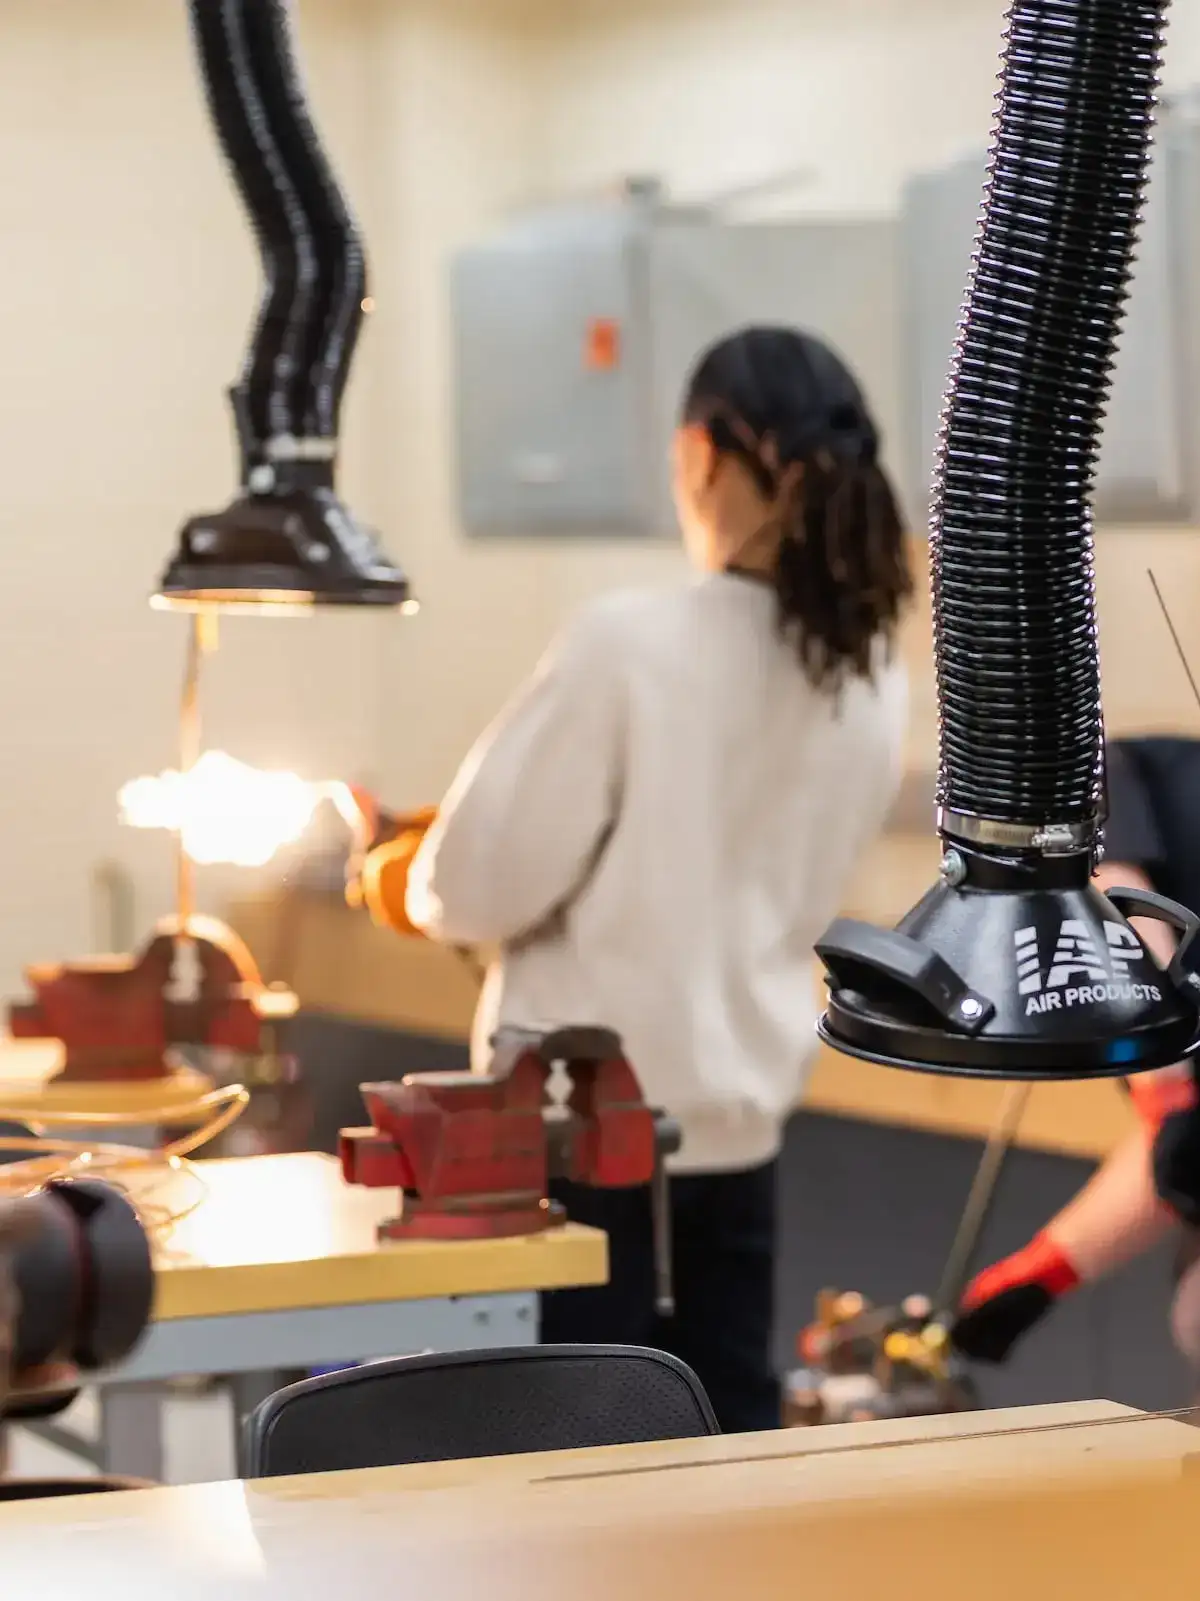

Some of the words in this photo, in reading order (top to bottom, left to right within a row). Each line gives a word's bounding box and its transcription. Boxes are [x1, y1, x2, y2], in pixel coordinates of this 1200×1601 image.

[1014, 920, 1143, 995] IAP
[1025, 991, 1062, 1016] AIR
[1065, 984, 1161, 1006] PRODUCTS
